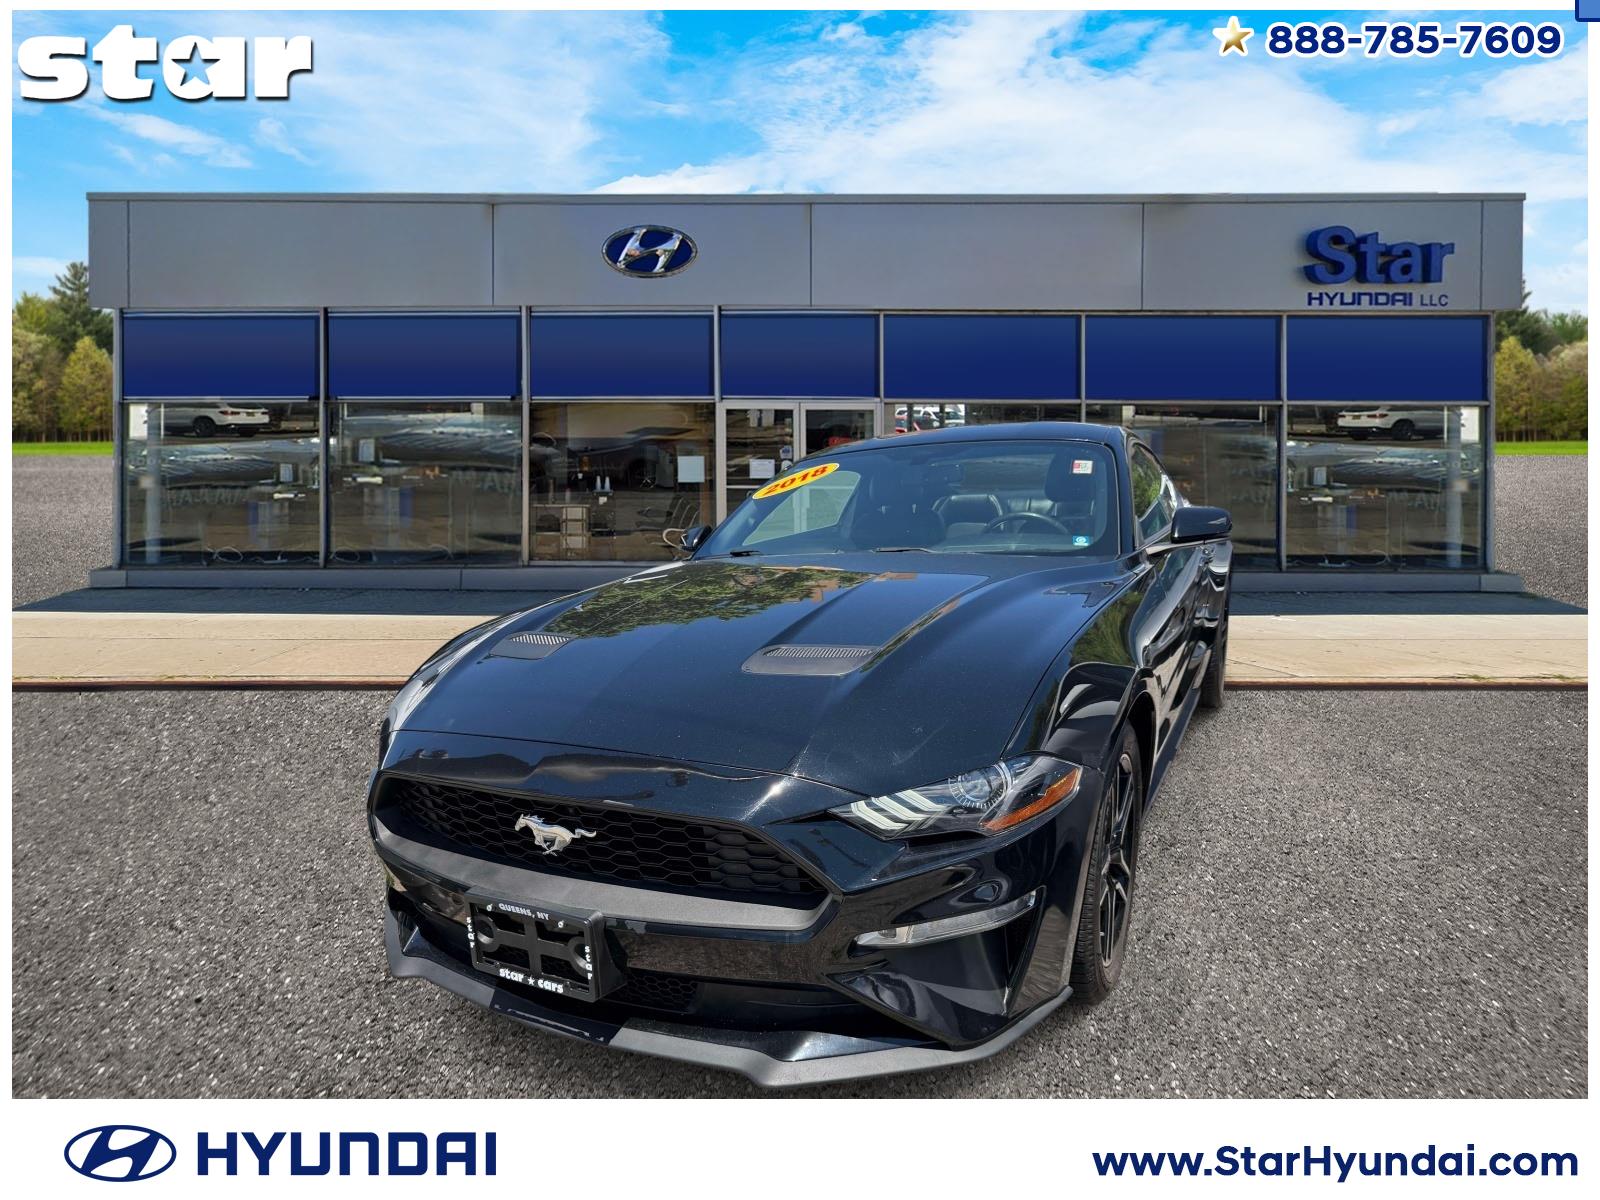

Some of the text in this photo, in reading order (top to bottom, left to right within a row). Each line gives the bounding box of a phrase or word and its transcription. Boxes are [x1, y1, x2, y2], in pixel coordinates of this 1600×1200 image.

[1303, 225, 1455, 284] Star
[1307, 292, 1449, 307] HYUNDAI LLC
[762, 466, 829, 496] 2018
[498, 903, 550, 921] QUEENS, NY
[466, 916, 476, 949] star
[584, 945, 593, 980] star
[499, 968, 564, 994] star cars
